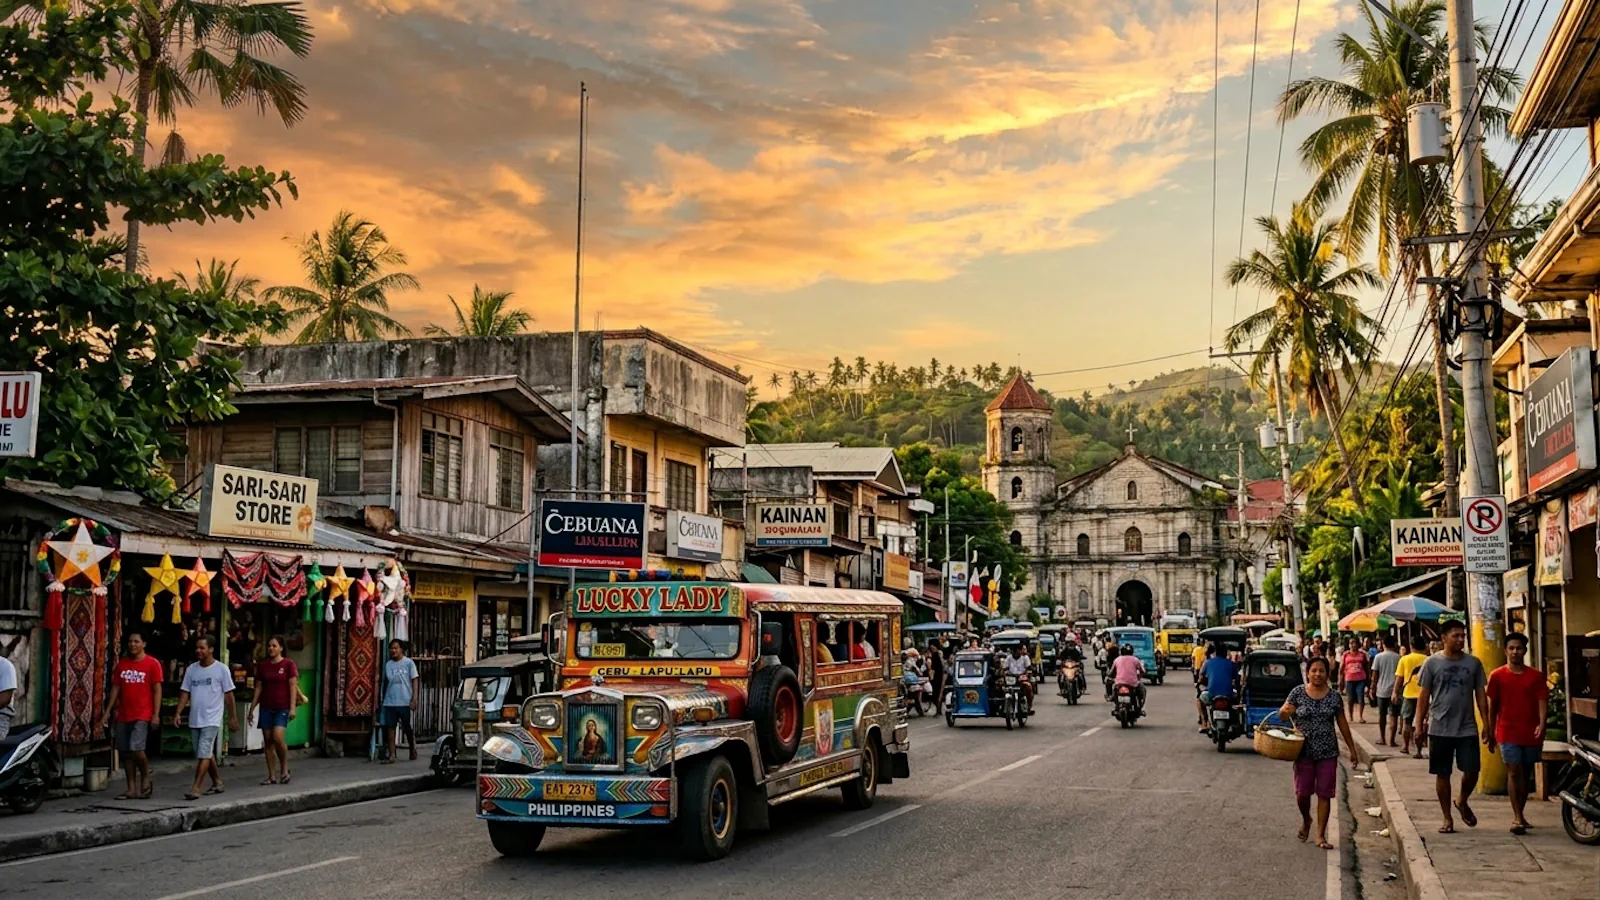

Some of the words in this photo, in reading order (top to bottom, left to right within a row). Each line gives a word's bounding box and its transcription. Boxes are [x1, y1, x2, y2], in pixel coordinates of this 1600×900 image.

[222, 473, 307, 504] SARI-SARI
[235, 500, 292, 525] STORE
[760, 507, 826, 523] KAINAN
[1396, 526, 1463, 545] KAINAN
[576, 586, 656, 613] LUCKY
[659, 585, 728, 612] LADY
[527, 803, 616, 818] PHILIPPINES
